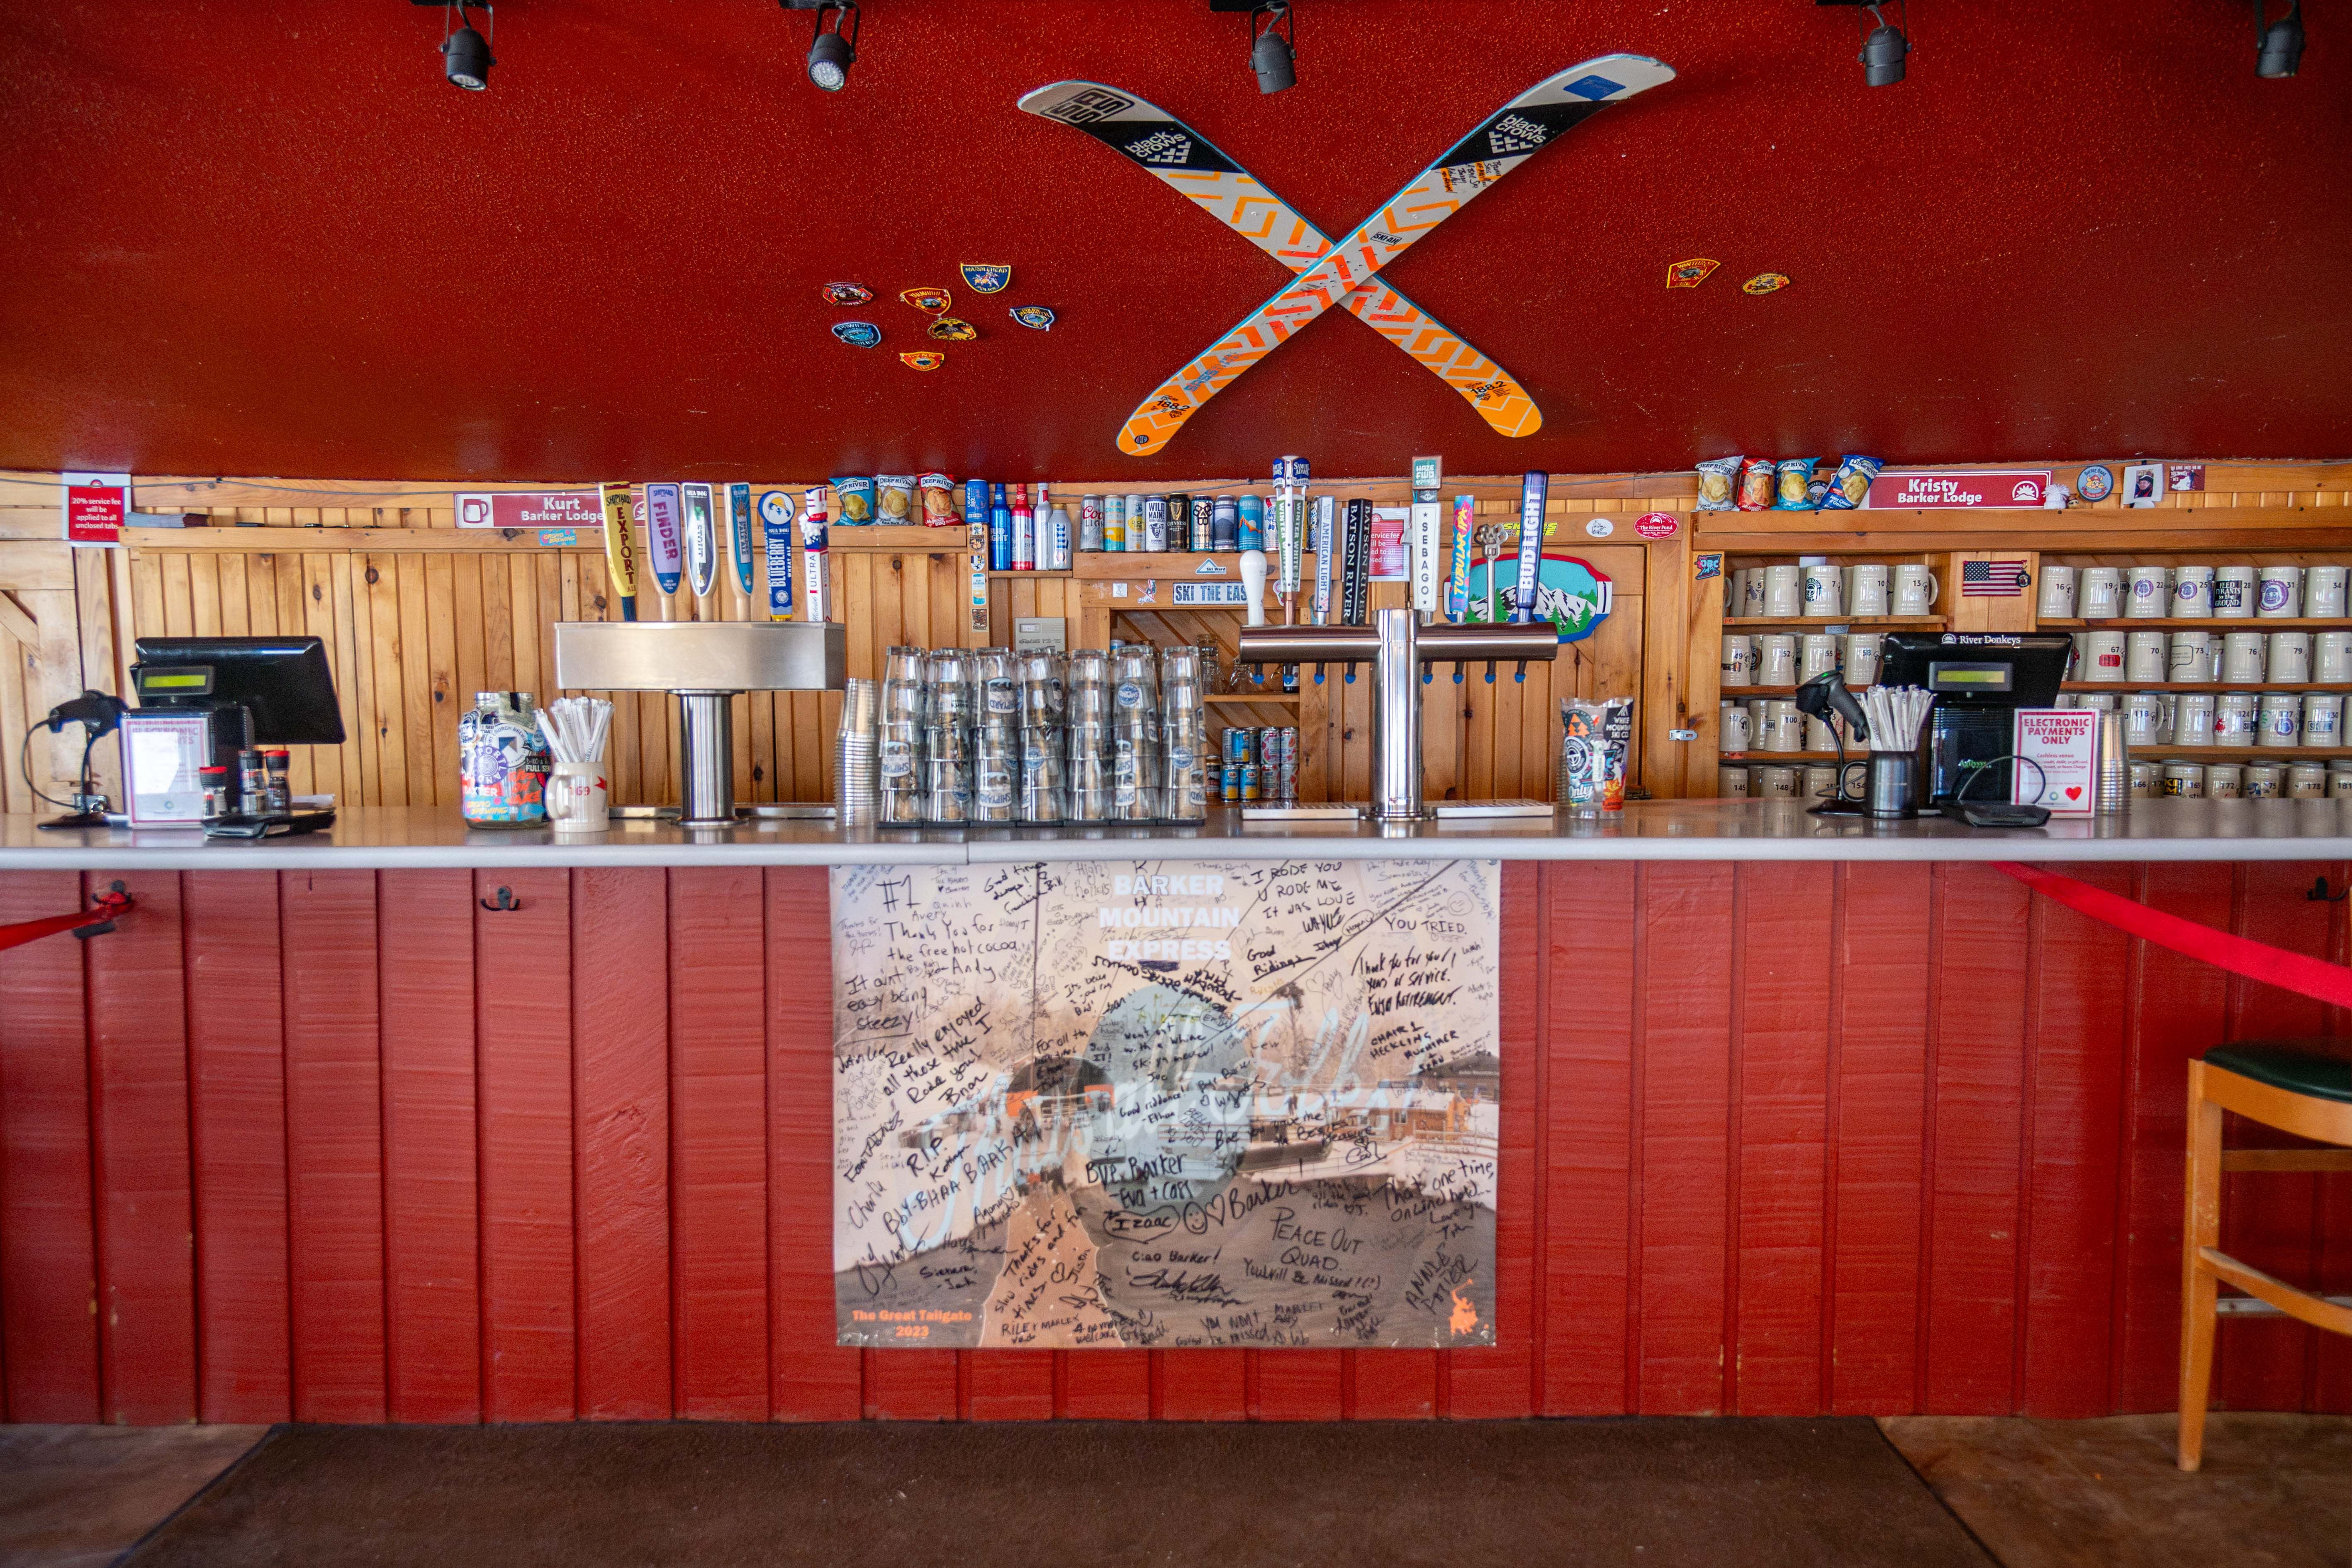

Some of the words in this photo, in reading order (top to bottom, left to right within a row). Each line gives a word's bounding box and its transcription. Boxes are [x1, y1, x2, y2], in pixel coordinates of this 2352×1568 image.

[1495, 124, 1546, 144] crows
[1503, 114, 1547, 135] black
[1126, 131, 1171, 153] black
[1136, 132, 1186, 158] crows
[1470, 381, 1507, 394] 188.2
[1157, 400, 1190, 411] 188.2
[1294, 461, 1309, 470] SAMUEL
[1714, 464, 1732, 474] RIVER
[837, 486, 847, 494] DEEP
[937, 478, 953, 488] RIVER
[1909, 478, 1958, 496] Kristy
[544, 497, 580, 510] Kurt
[606, 494, 631, 506] SHIPYARD
[1149, 503, 1165, 511] WILD
[1898, 492, 1941, 503] Barker
[1943, 492, 1982, 505] Lodge
[521, 511, 562, 521] Barker
[566, 510, 604, 523] Lodge
[1457, 507, 1468, 531] IPA
[1522, 490, 1541, 548] LIGHT
[653, 501, 679, 560] FINDER
[1347, 504, 1358, 566] BATSON
[1361, 506, 1371, 567] BATSON
[616, 506, 635, 584] EXPORT
[1320, 522, 1329, 564] AMERICAN
[769, 538, 786, 587] BLUEBERRY
[1454, 533, 1466, 595] TUBULAR
[1519, 549, 1536, 590] BUD
[1320, 567, 1328, 592] LIGHT
[1175, 585, 1194, 601] SKI
[1200, 585, 1221, 601] THE
[1343, 571, 1355, 618] RIVER
[1358, 572, 1367, 618] RIVER
[1959, 635, 1983, 644] River
[1984, 635, 2021, 645] Donkeys
[568, 786, 591, 796] 169
[1271, 864, 1308, 880] RODE
[1317, 862, 1343, 872] YOU
[1115, 874, 1224, 895] BARKER
[1099, 907, 1240, 928] MOUNTAIN
[1384, 916, 1417, 931] YOU
[888, 947, 914, 962] the
[919, 944, 949, 957] free
[952, 939, 974, 954] hot
[978, 941, 1017, 951] cocoa
[1108, 940, 1232, 961] EXPRESS
[953, 956, 996, 983] Andy
[852, 1310, 876, 1321] The
[879, 1310, 916, 1322] Great
[919, 1310, 972, 1322] Tailgate
[896, 1326, 929, 1337] 2023
